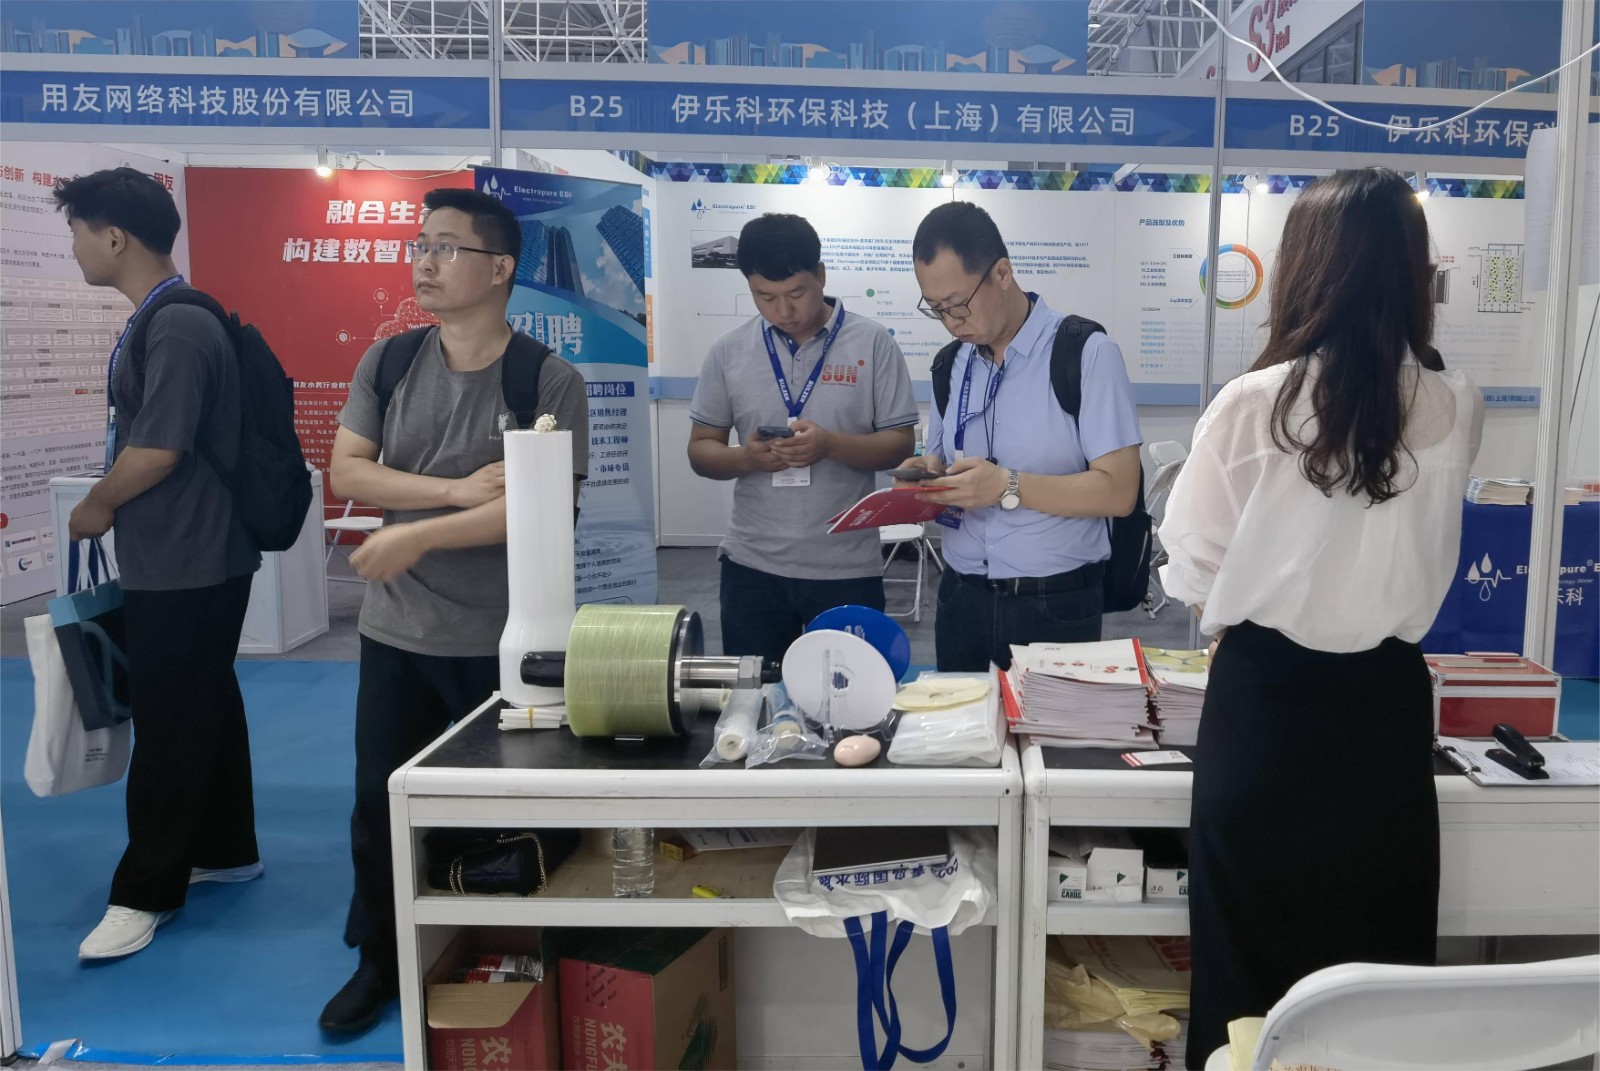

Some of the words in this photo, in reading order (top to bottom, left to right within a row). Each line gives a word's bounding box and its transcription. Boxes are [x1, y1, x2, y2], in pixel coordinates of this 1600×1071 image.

[41, 83, 415, 118] 用友网络科技股份有限公司
[569, 95, 624, 118] B25
[672, 94, 1136, 136] 伊乐科环保科技（上海）有限公司
[1290, 115, 1340, 137] B25
[33, 171, 71, 188] 构建水
[326, 200, 432, 225] 融合生
[588, 408, 628, 418] 区销售经理
